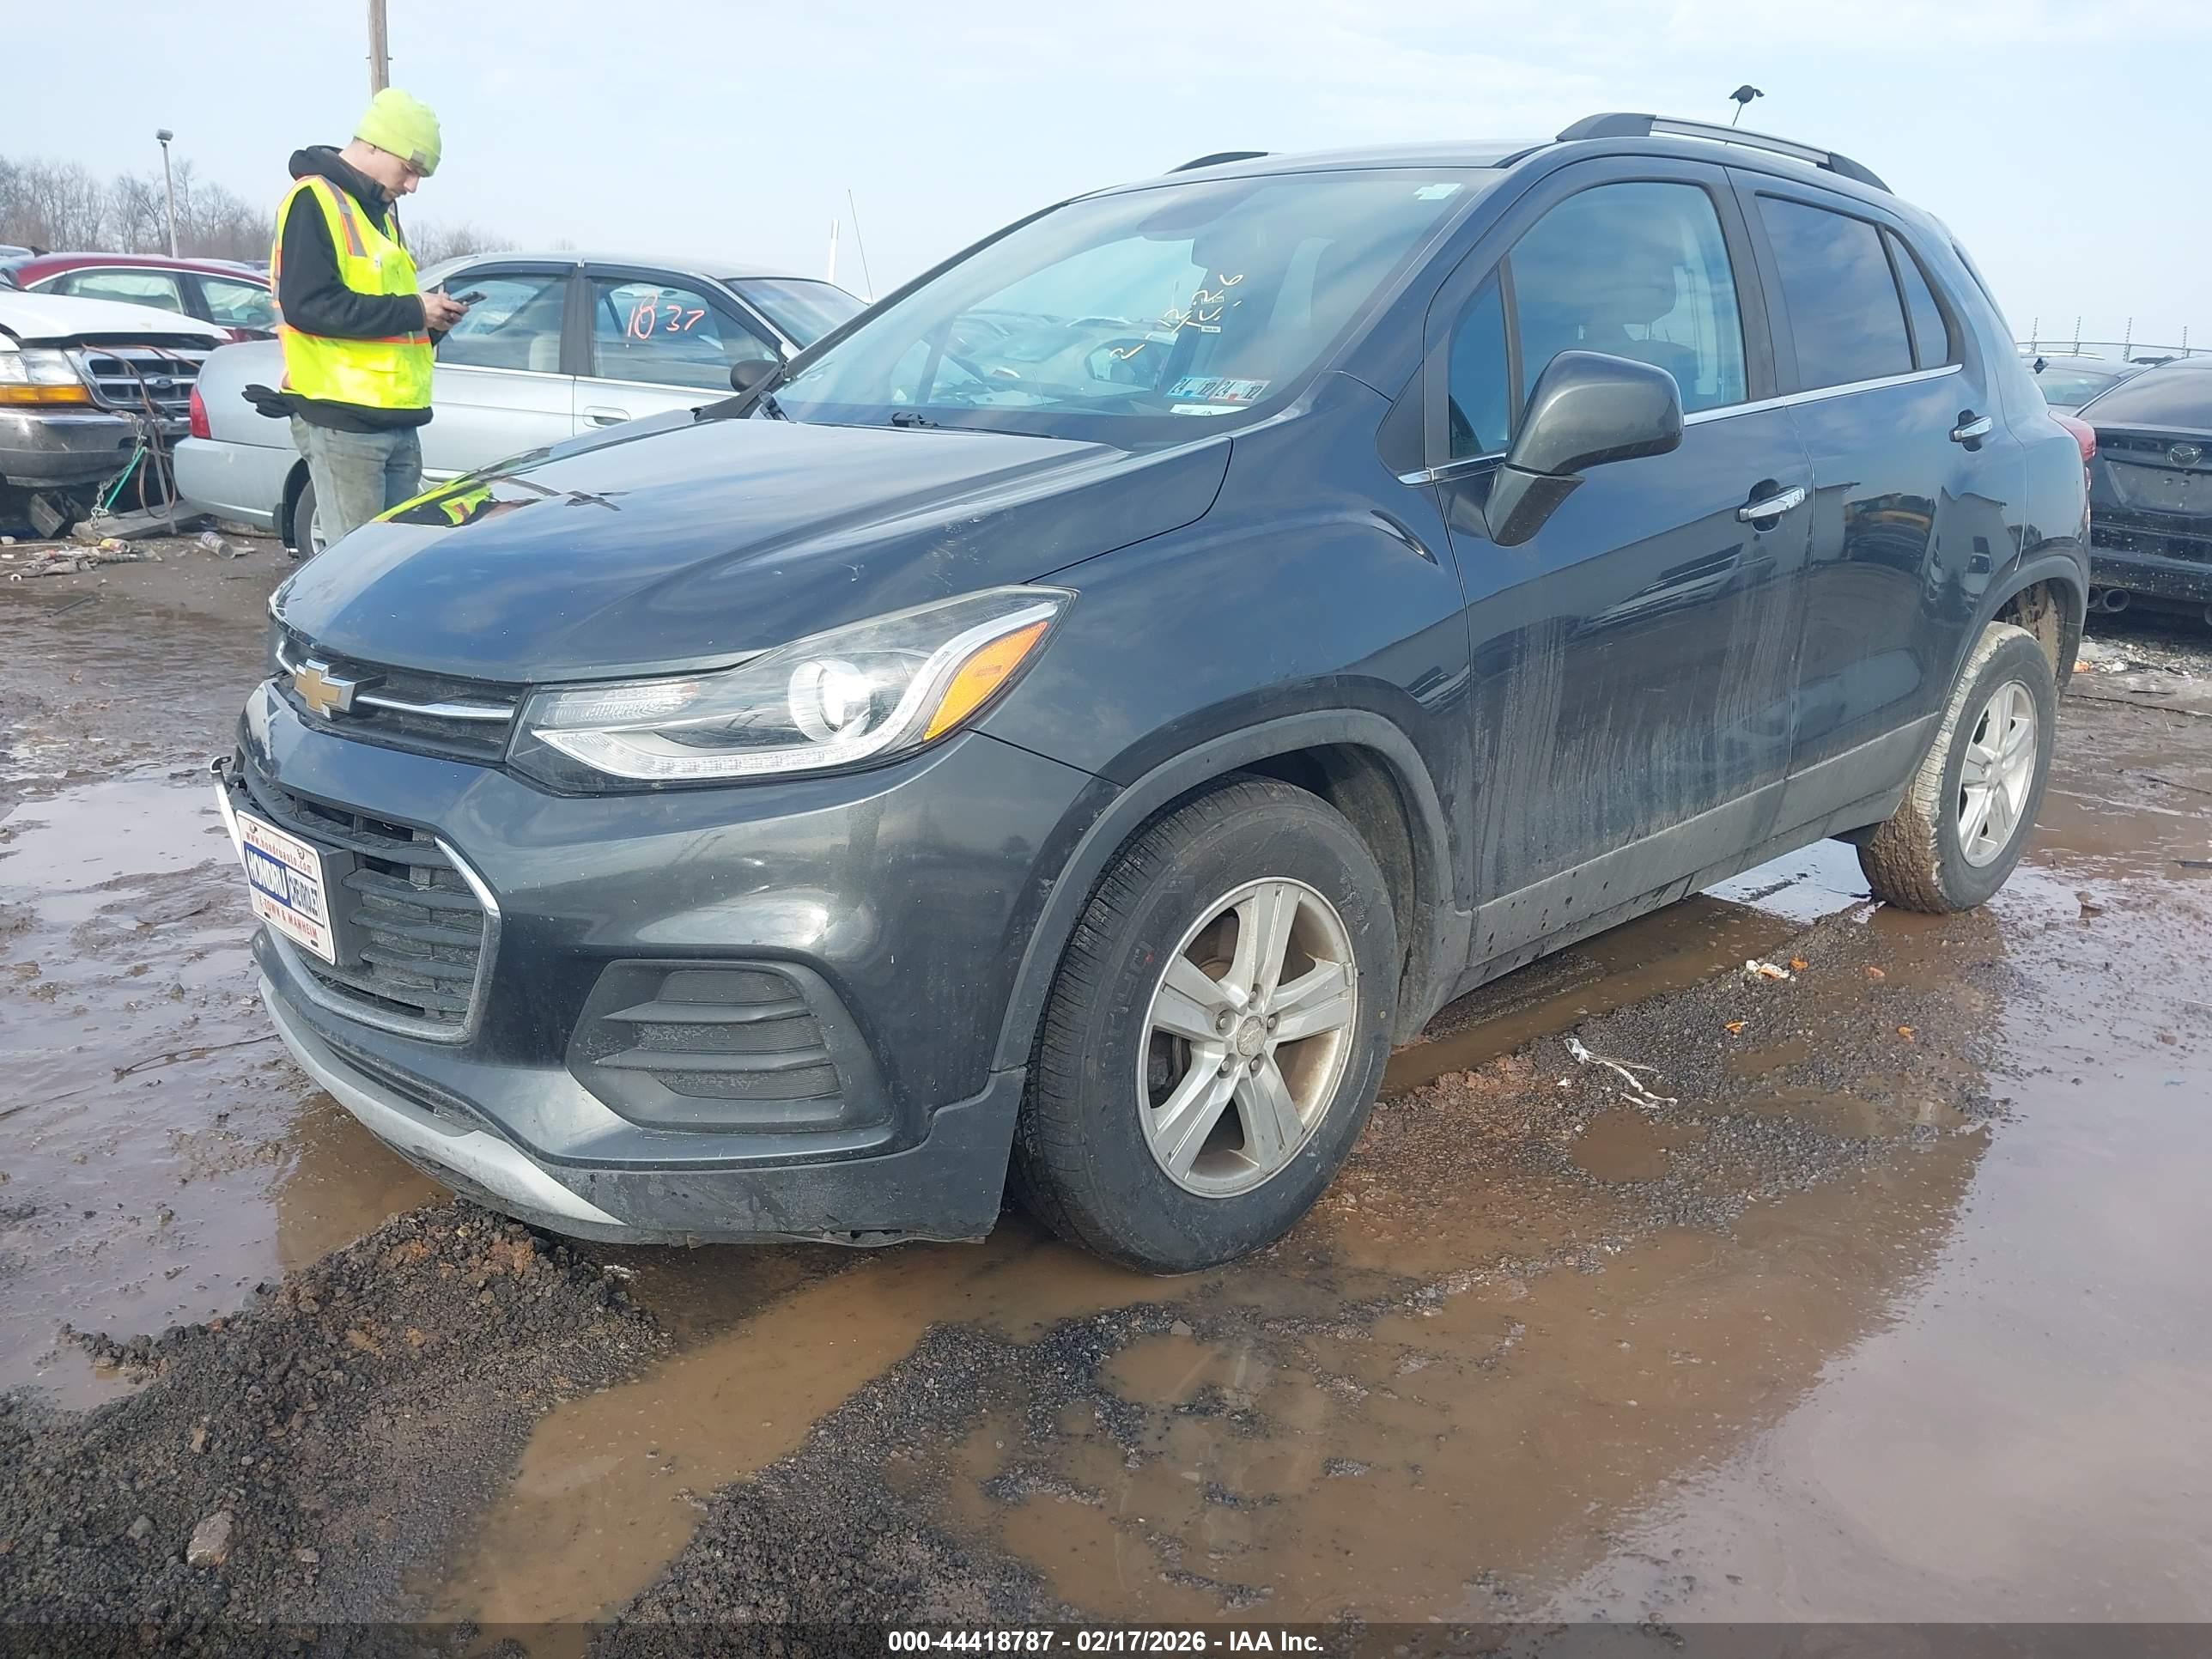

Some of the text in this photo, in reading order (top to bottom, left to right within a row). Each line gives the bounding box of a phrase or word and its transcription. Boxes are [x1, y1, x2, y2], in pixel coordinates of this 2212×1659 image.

[1170, 378, 1192, 393] 24
[1215, 380, 1263, 399] 24 12
[246, 848, 289, 900] HONDRU
[288, 913, 318, 938] MANHEIM
